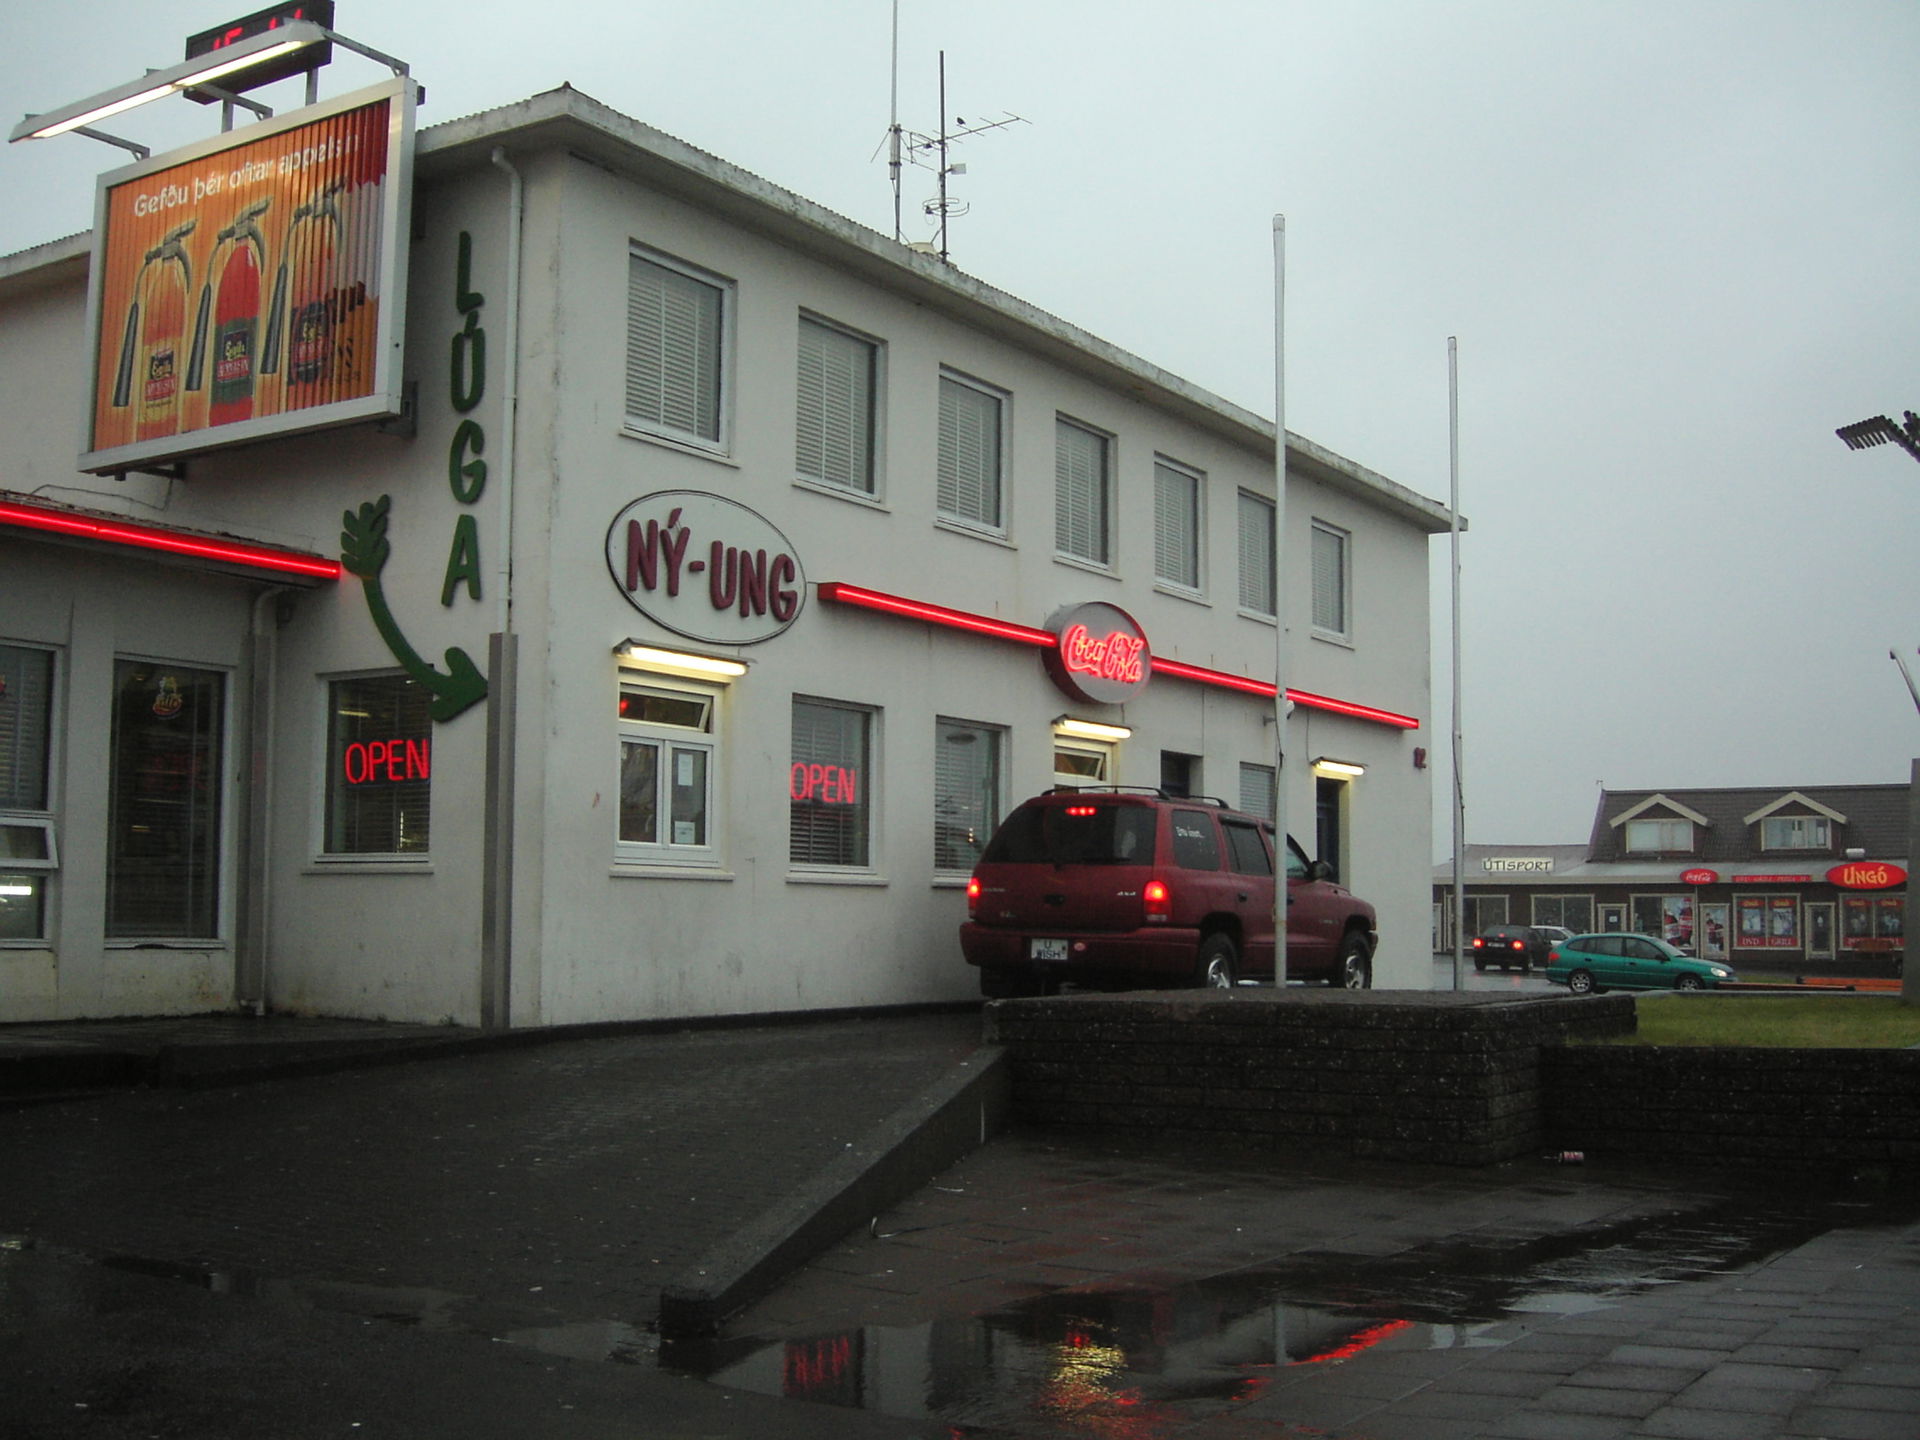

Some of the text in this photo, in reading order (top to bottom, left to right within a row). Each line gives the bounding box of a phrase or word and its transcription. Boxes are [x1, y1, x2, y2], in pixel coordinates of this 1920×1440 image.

[135, 186, 188, 217] Gefðu
[194, 172, 223, 204] þér
[229, 158, 273, 189] oftar
[441, 231, 487, 607] LÚGA
[627, 507, 797, 622] NÝ-UNG
[345, 738, 429, 784] OPEN
[790, 762, 855, 804] OPEN
[1483, 857, 1551, 871] ÚTISPORT
